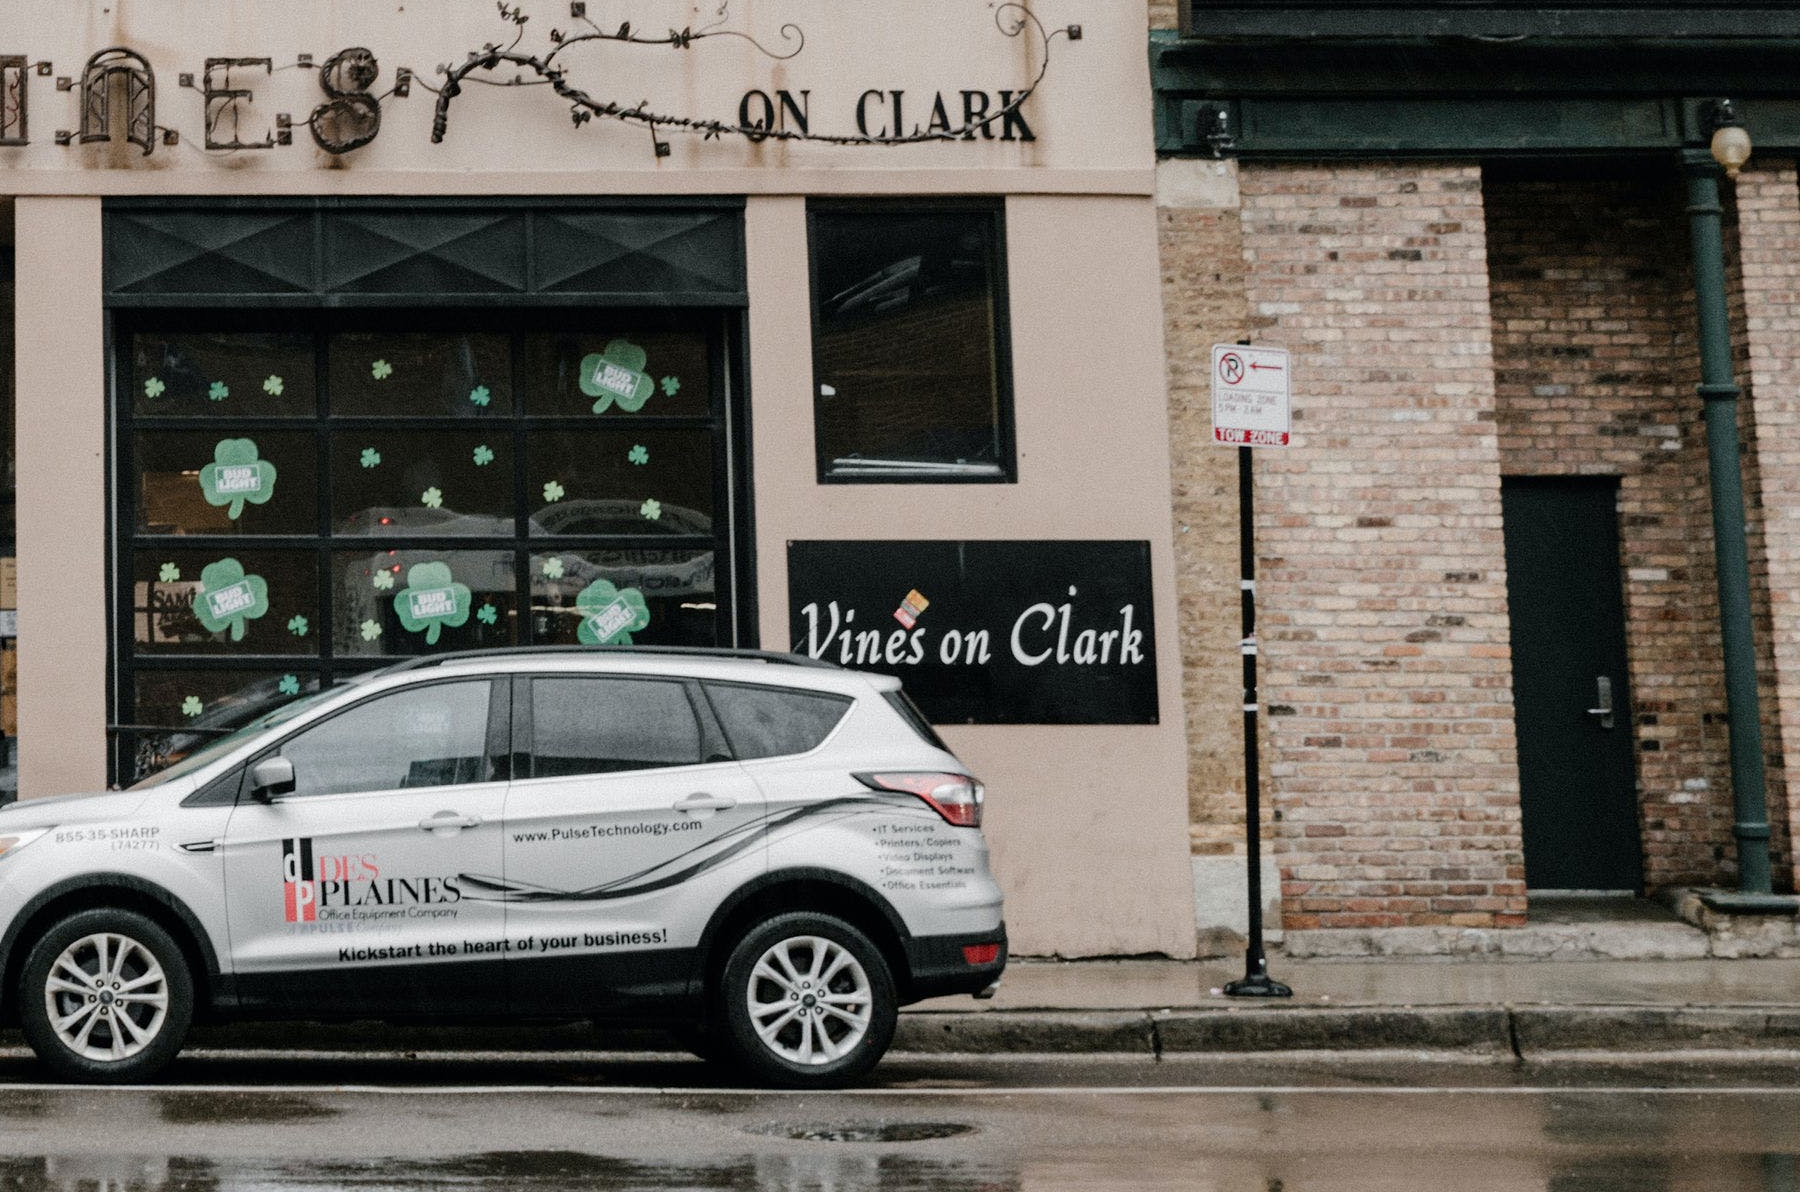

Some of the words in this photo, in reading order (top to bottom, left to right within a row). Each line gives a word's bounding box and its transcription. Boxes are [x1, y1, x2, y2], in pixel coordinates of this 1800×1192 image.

[738, 89, 811, 142] ON
[856, 89, 1036, 143] CLARK
[1219, 428, 1245, 441] TOW
[1251, 430, 1284, 445] ZONE
[801, 600, 925, 665] Vines
[939, 629, 991, 665] on
[1010, 584, 1144, 666] Clark
[513, 819, 702, 843] www.PulseTechnology.com
[892, 824, 935, 833] Services
[111, 840, 160, 852] (74277)
[913, 852, 953, 863] Displays
[319, 854, 379, 881] DES
[937, 866, 975, 875] Software
[320, 875, 461, 907] PLAINES
[887, 881, 916, 890] Office
[919, 881, 966, 890] Essentials
[319, 908, 350, 921] Office
[352, 907, 406, 922] Equipment
[408, 906, 458, 920] Company
[339, 943, 422, 962] Kickstart
[428, 941, 457, 956] the
[463, 939, 511, 954] heart
[517, 935, 534, 950] of
[540, 936, 577, 952] your
[584, 928, 667, 947] business!
